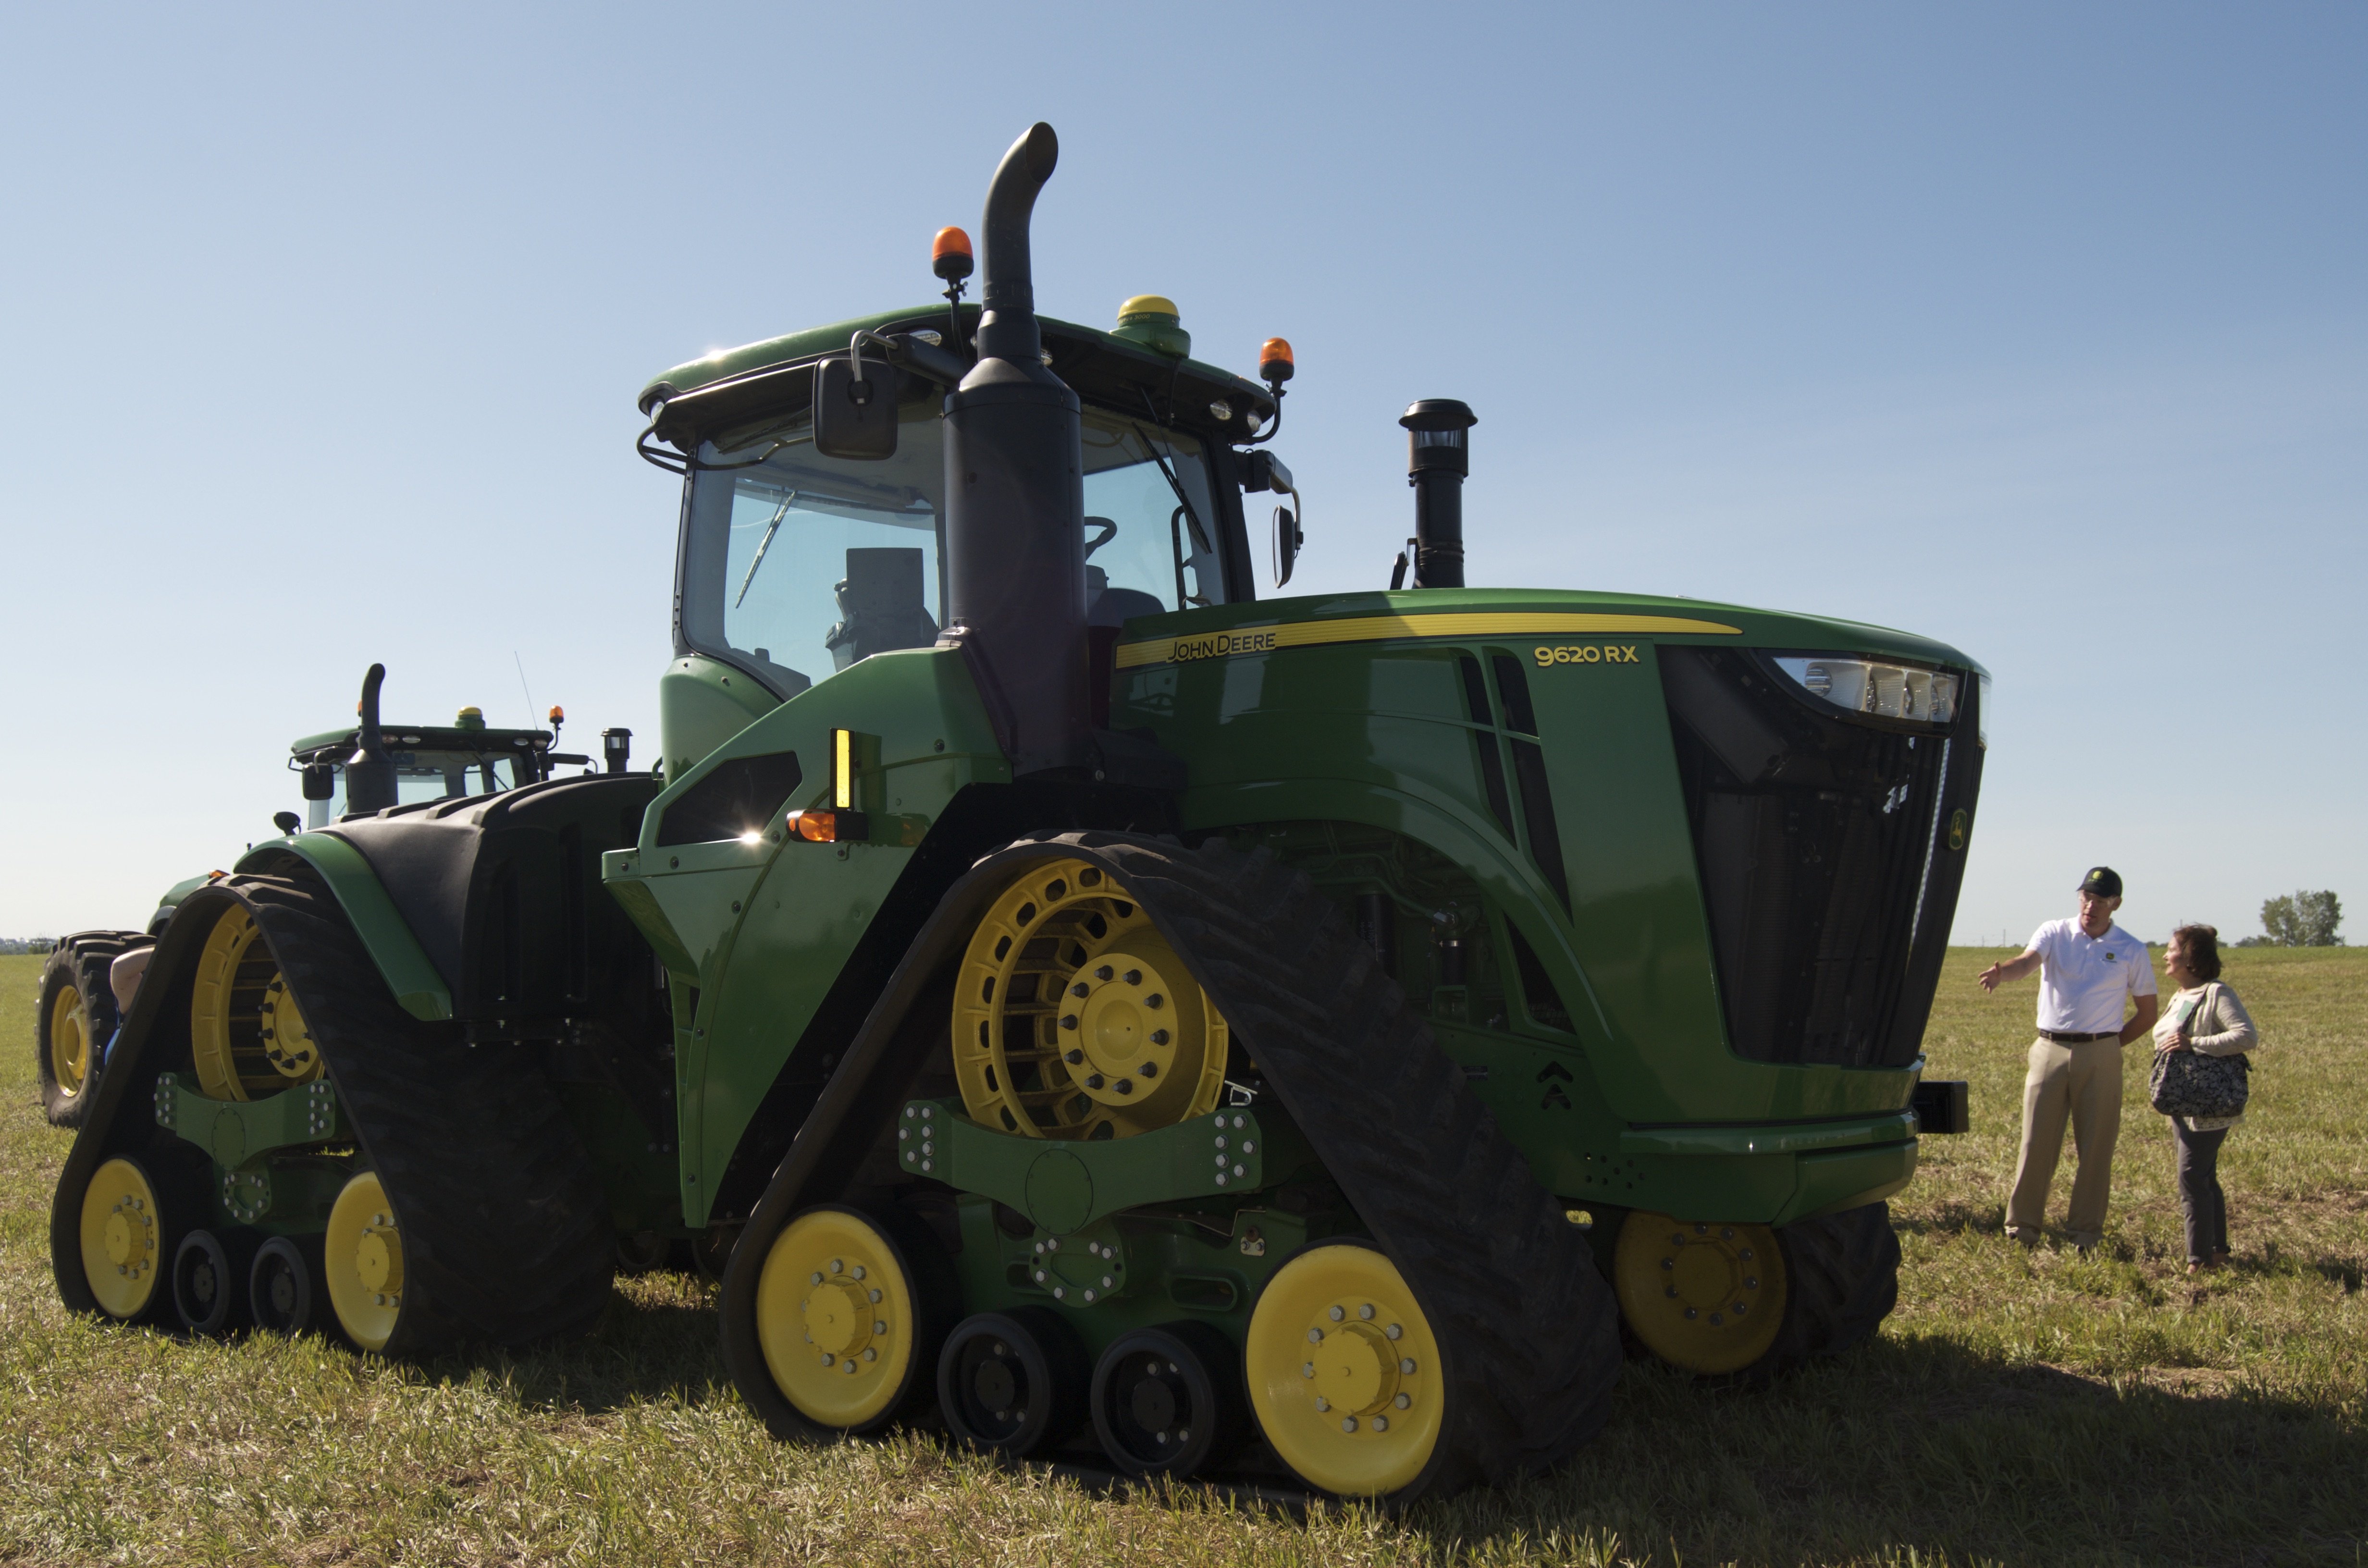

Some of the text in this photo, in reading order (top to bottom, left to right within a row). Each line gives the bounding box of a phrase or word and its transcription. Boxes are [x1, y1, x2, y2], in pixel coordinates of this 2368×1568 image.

[1167, 633, 1276, 661] JOHN DEERE
[1534, 646, 1640, 667] 9620 RX
